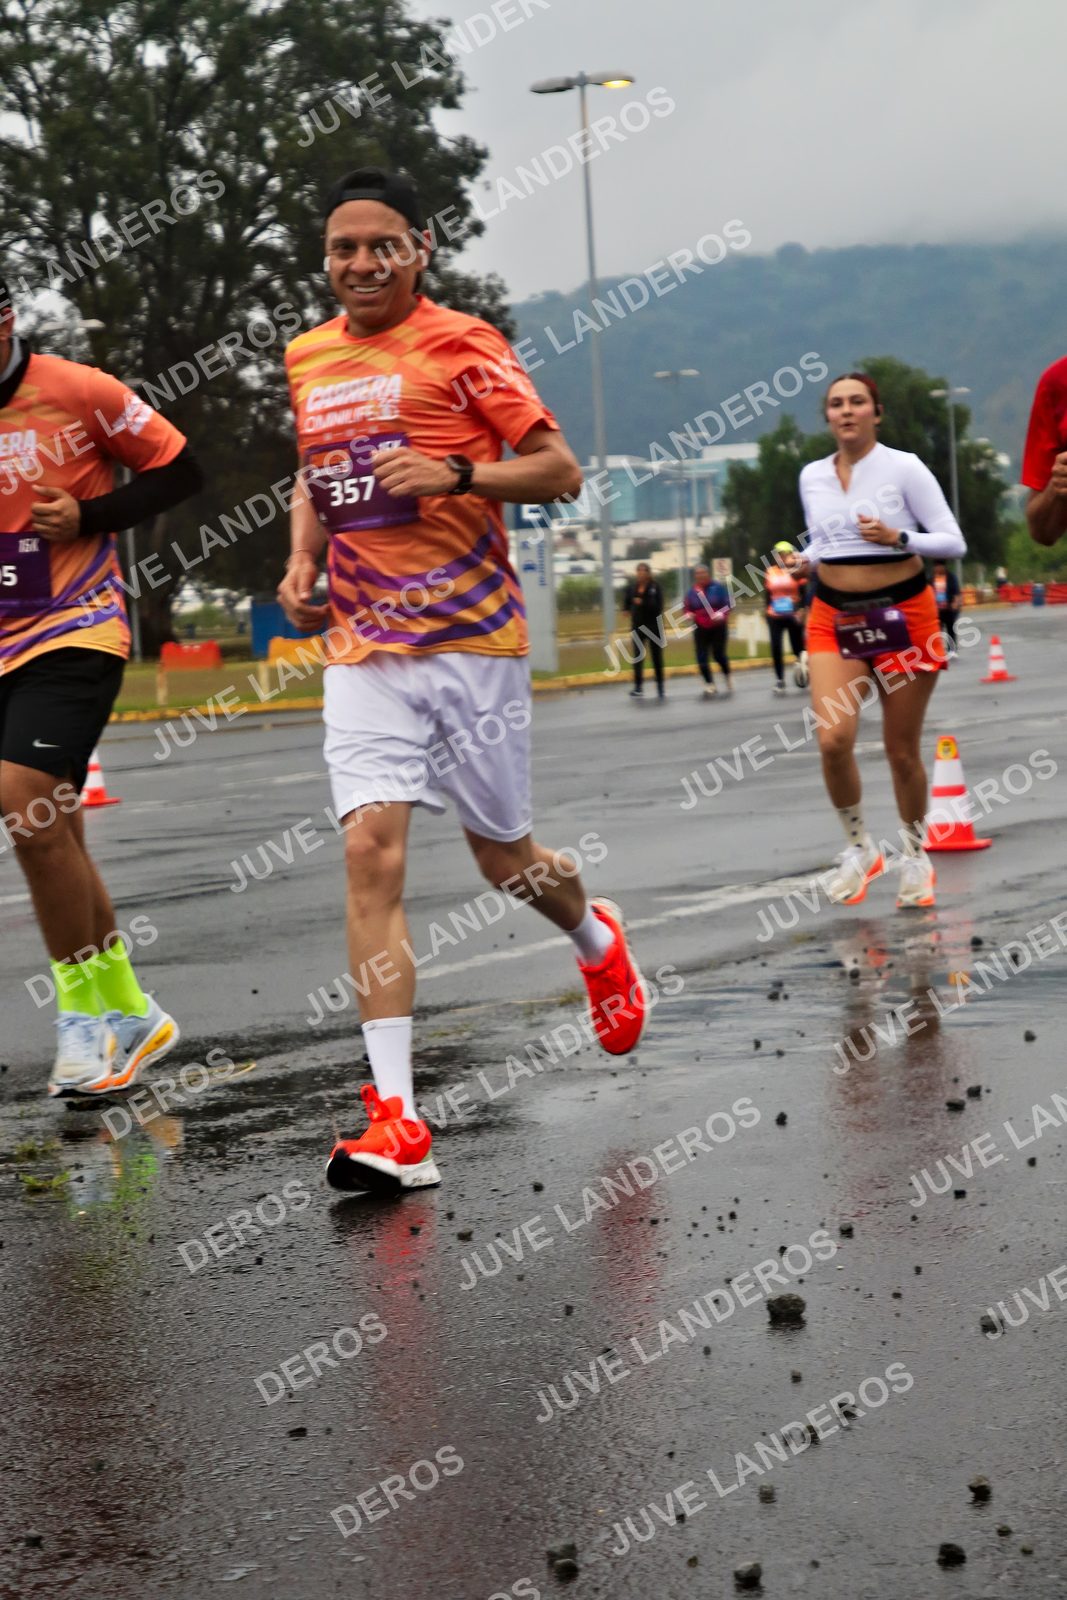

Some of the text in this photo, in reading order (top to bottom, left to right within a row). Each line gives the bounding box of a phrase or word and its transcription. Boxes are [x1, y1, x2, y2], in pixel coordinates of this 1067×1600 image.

[330, 476, 375, 507] 357
[0, 565, 18, 586] 5
[853, 628, 887, 643] 134
